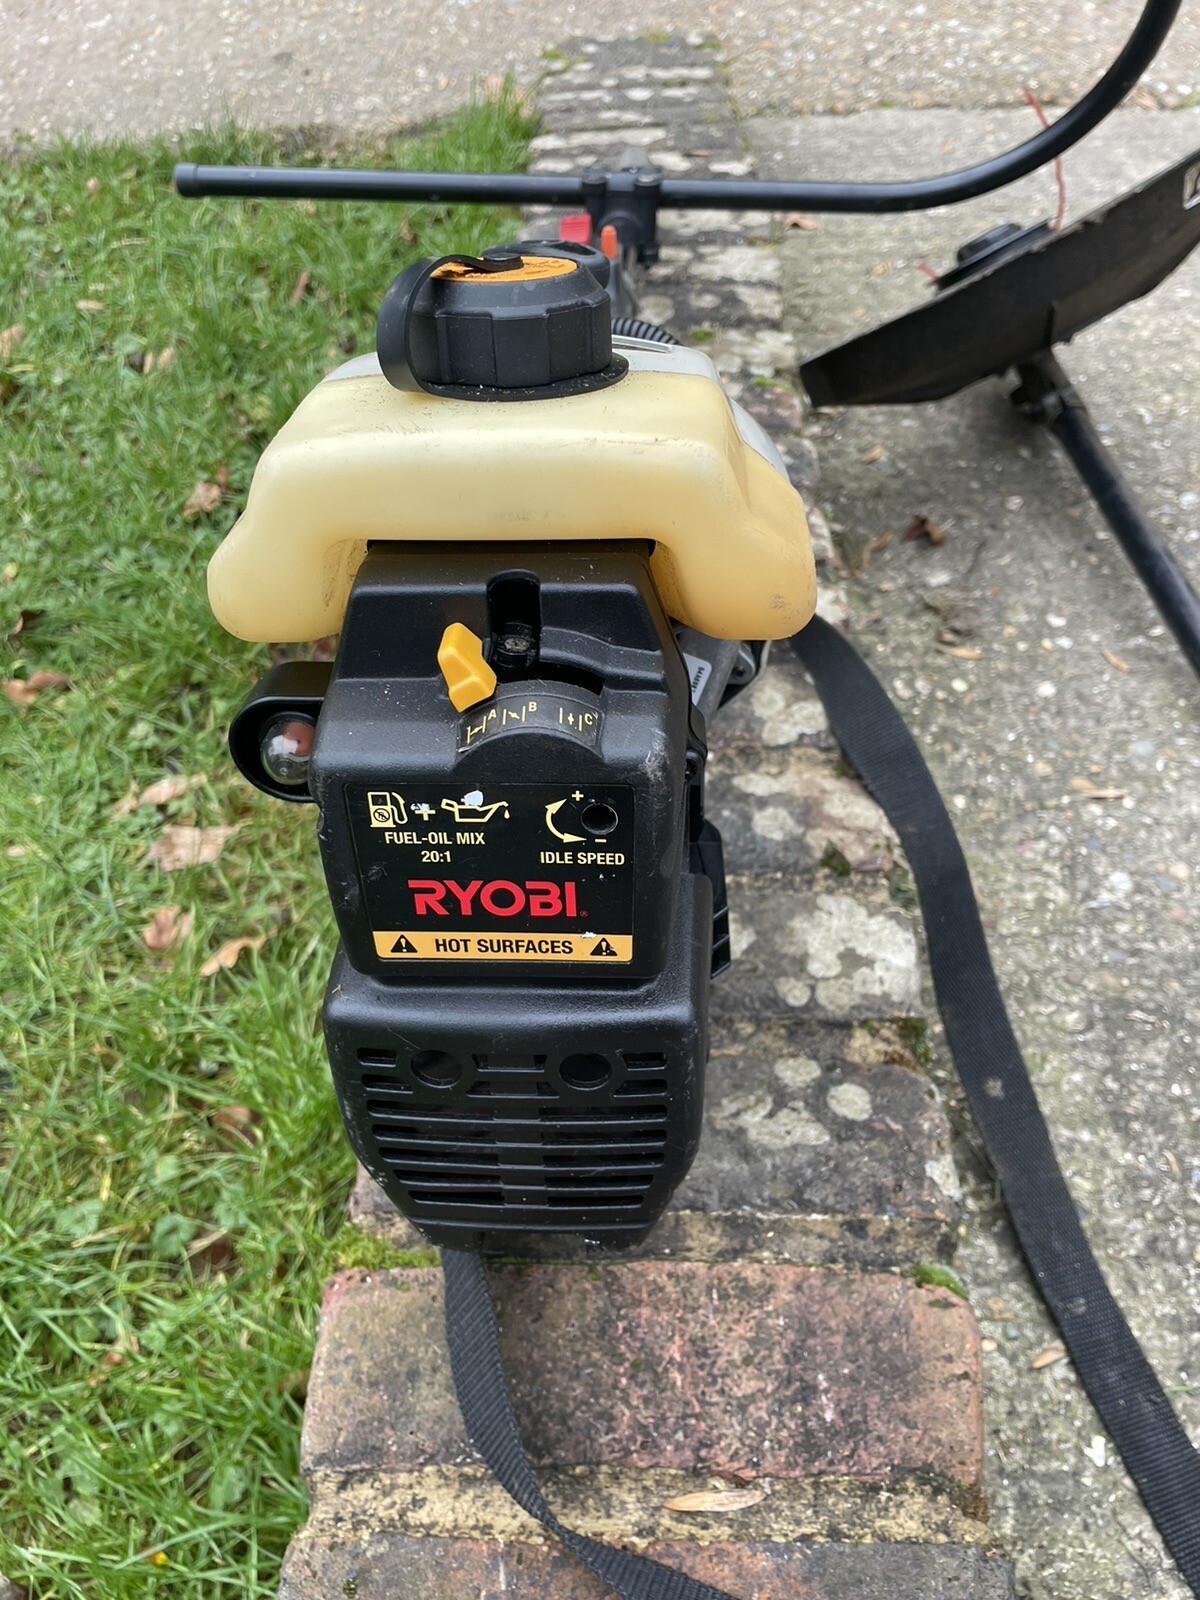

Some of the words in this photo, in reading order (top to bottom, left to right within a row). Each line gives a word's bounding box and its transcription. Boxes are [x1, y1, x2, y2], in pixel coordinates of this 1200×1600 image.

[528, 701, 538, 712] B
[384, 831, 453, 845] FUEL-OIL
[456, 832, 486, 845] MIX
[420, 850, 452, 863] 20:1
[540, 851, 573, 865] IDLE
[577, 852, 625, 866] SPEED
[407, 879, 578, 917] RYOBI
[435, 938, 471, 953] HOT
[477, 939, 574, 955] SURFACES
